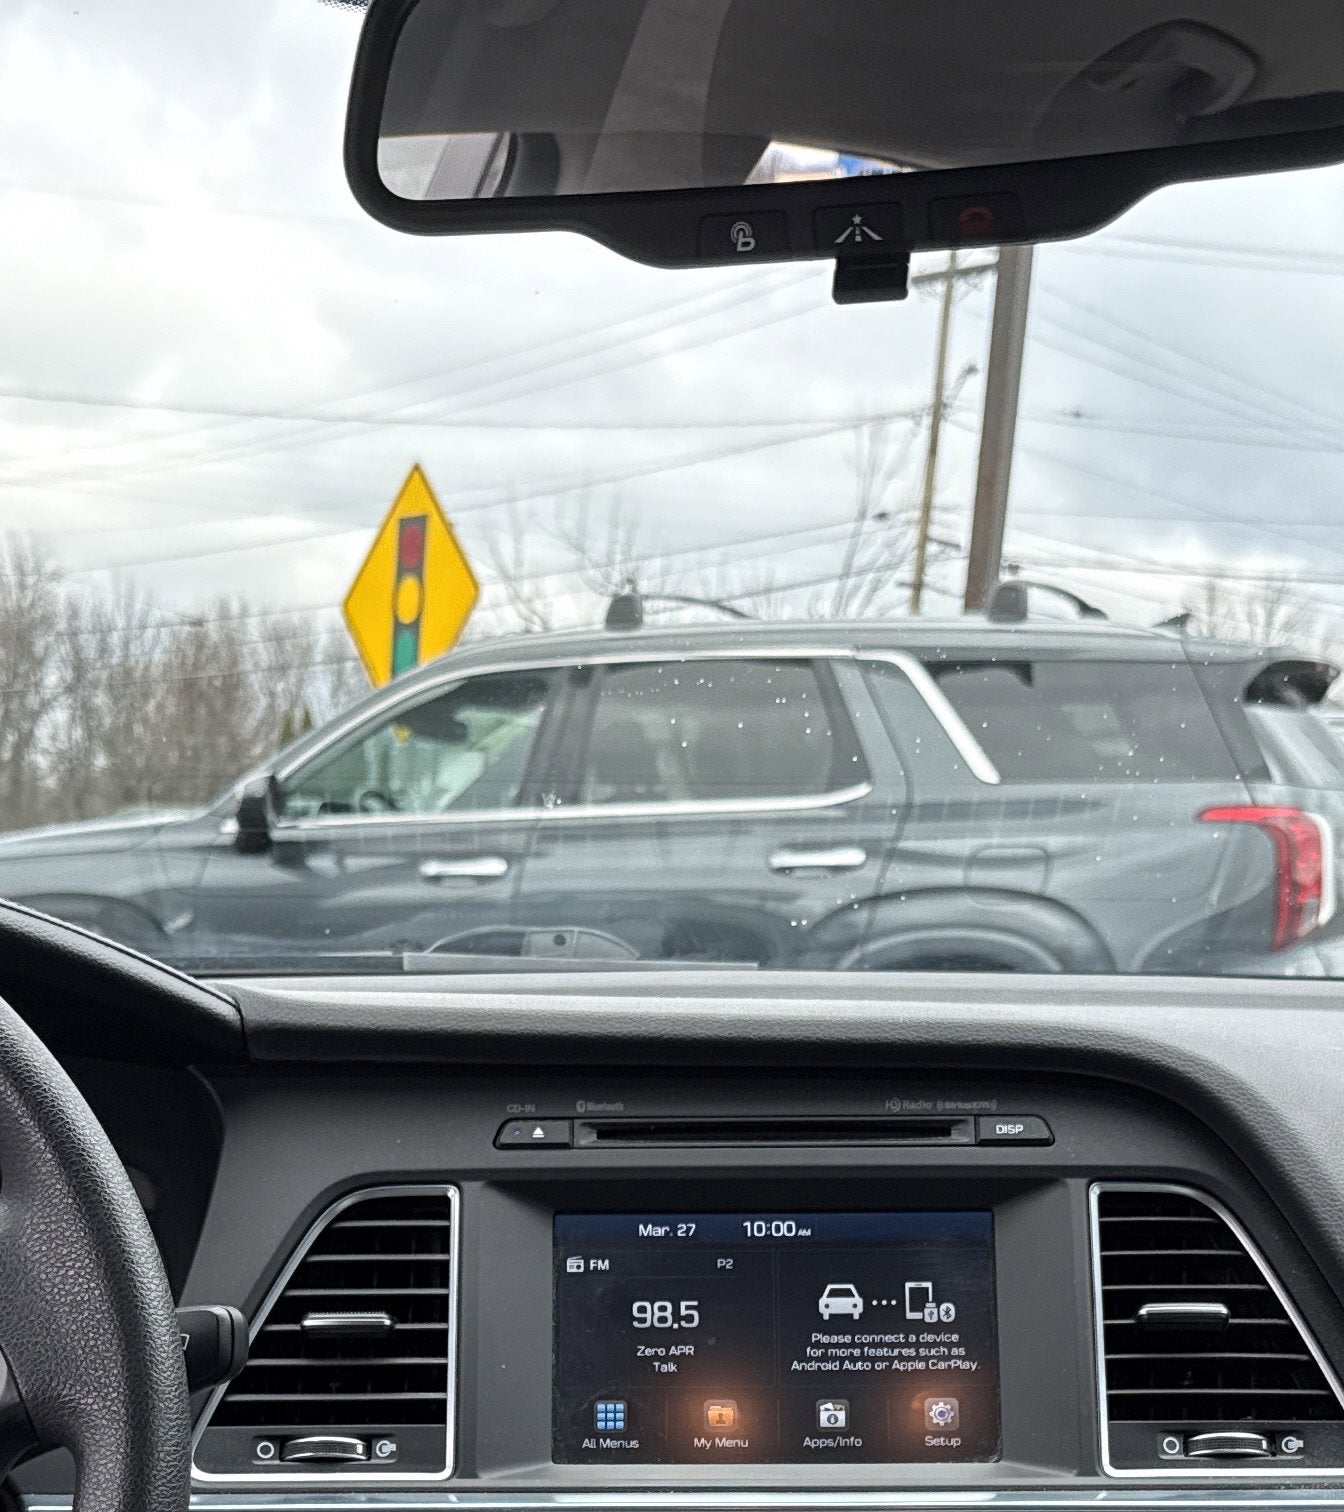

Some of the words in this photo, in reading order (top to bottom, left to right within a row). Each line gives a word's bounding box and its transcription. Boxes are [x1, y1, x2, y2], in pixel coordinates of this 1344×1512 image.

[995, 1124, 1024, 1134] DISP
[639, 1224, 673, 1237] Mar.
[677, 1224, 696, 1237] 27
[743, 1221, 796, 1237] 10:00
[590, 1259, 610, 1271] FM
[717, 1258, 734, 1270] P2
[632, 1300, 700, 1329] 98.5
[812, 1333, 852, 1344] Please
[855, 1333, 906, 1344] connect
[908, 1334, 917, 1343] a
[919, 1333, 959, 1343] device
[636, 1346, 666, 1356] Zero
[669, 1346, 695, 1356] APR
[806, 1346, 825, 1357] for
[827, 1347, 861, 1357] more
[864, 1346, 916, 1357] features
[918, 1346, 948, 1356] such
[951, 1347, 965, 1356] as
[653, 1362, 678, 1373] Talk
[791, 1360, 840, 1371] Android
[842, 1360, 871, 1371] Auto
[874, 1361, 889, 1371] or
[891, 1360, 926, 1372] Apple
[582, 1438, 596, 1449] All
[599, 1438, 639, 1449] Menus
[694, 1437, 712, 1449] My
[715, 1437, 749, 1448] Menu
[802, 1436, 862, 1448] Apps/Info
[925, 1436, 961, 1447] Setup
